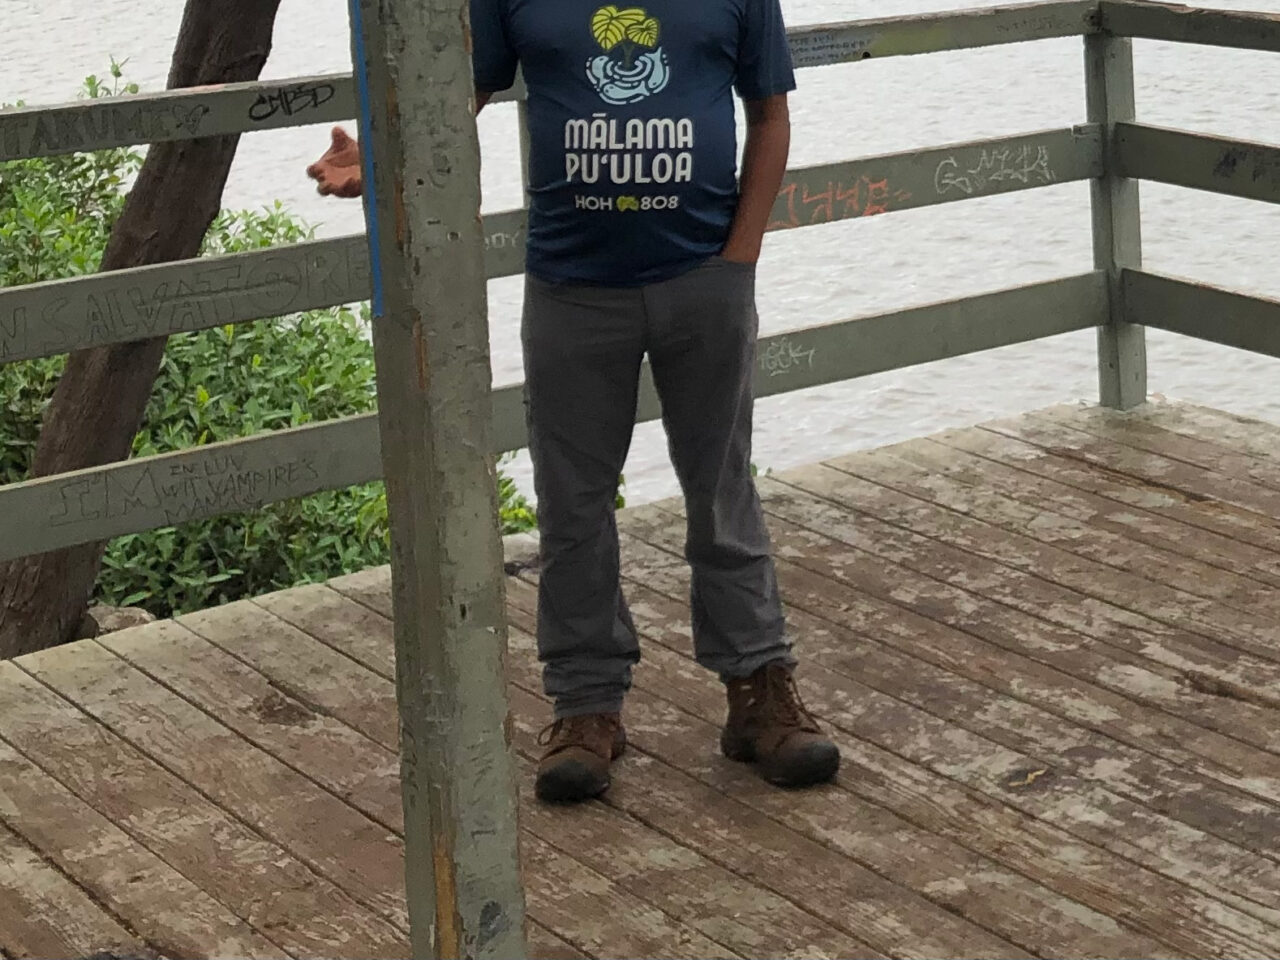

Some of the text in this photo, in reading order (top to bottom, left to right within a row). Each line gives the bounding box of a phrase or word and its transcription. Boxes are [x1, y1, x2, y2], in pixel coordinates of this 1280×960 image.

[564, 112, 694, 150] MĀLAMA
[575, 194, 679, 212] HOH 808
